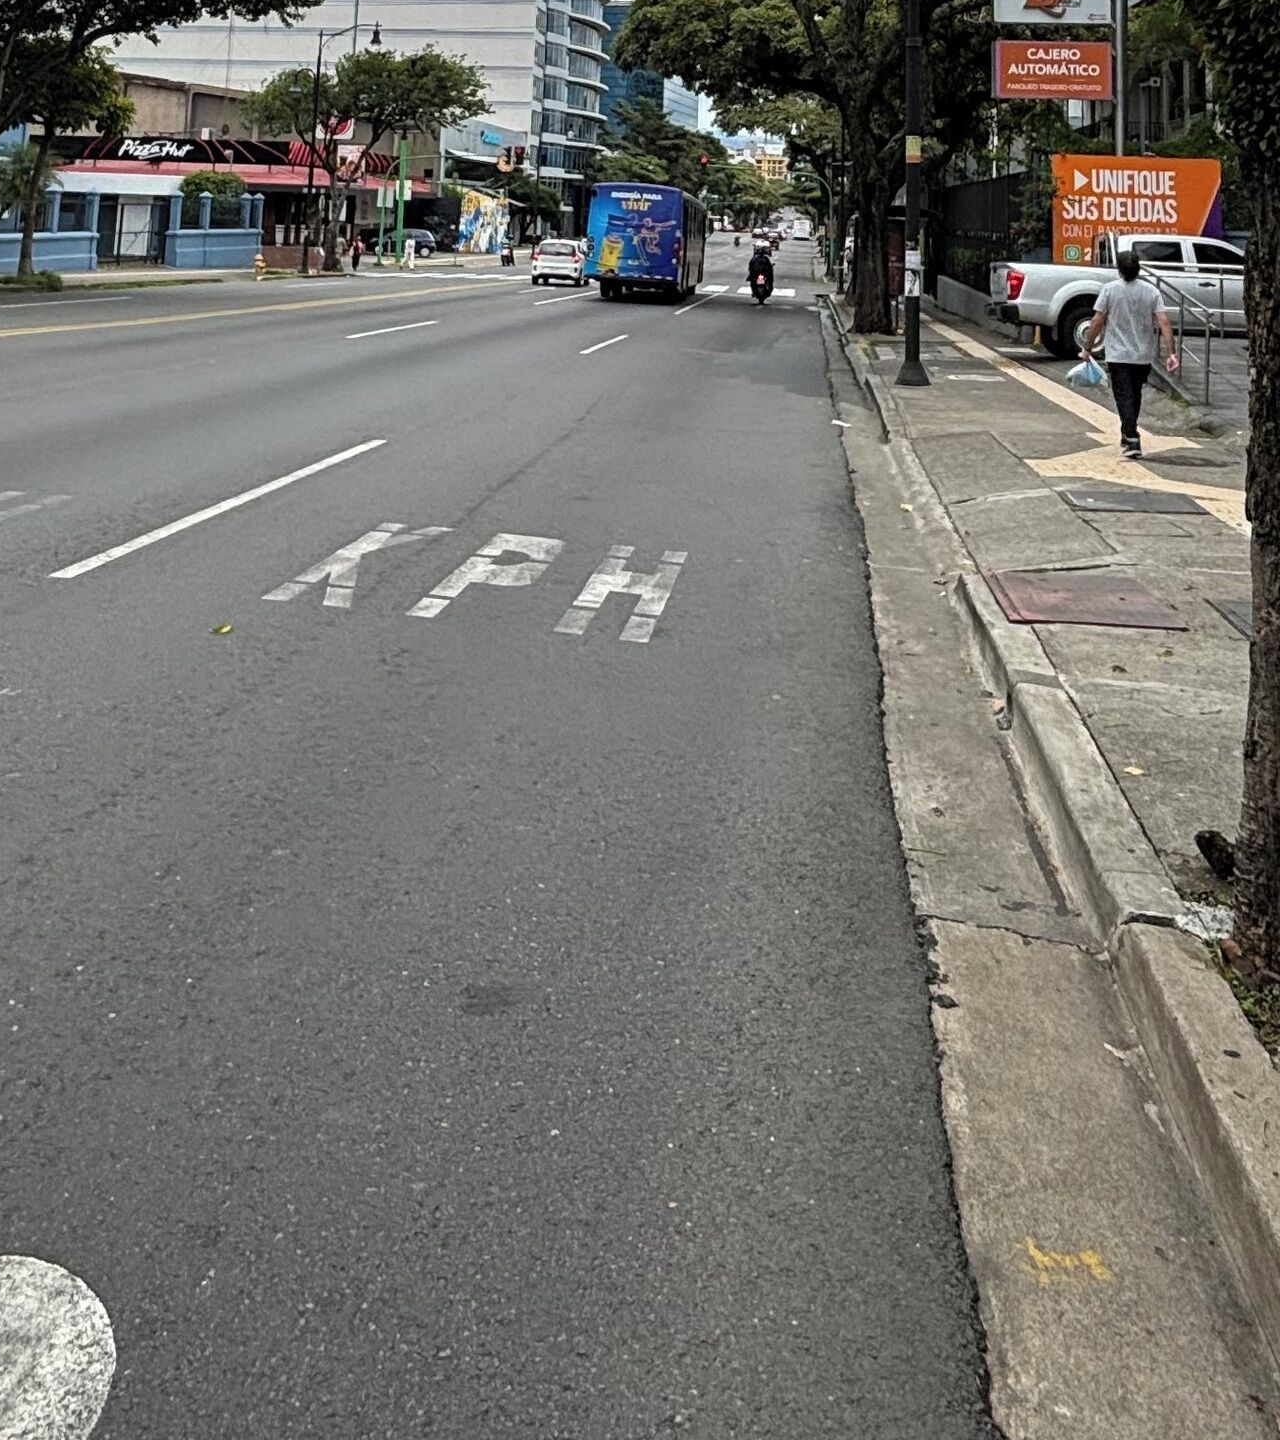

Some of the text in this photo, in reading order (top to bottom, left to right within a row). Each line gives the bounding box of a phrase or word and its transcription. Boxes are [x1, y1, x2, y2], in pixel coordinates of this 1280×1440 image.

[1027, 48, 1080, 60] CAJERO
[1008, 62, 1100, 76] AUTOMÁTICO
[118, 139, 195, 157] Pizza Hut
[1091, 168, 1176, 196] UNIFIQUE
[1062, 195, 1177, 224] SUS DEUDAS
[1062, 223, 1082, 237] CON
[261, 522, 689, 644] KPH
